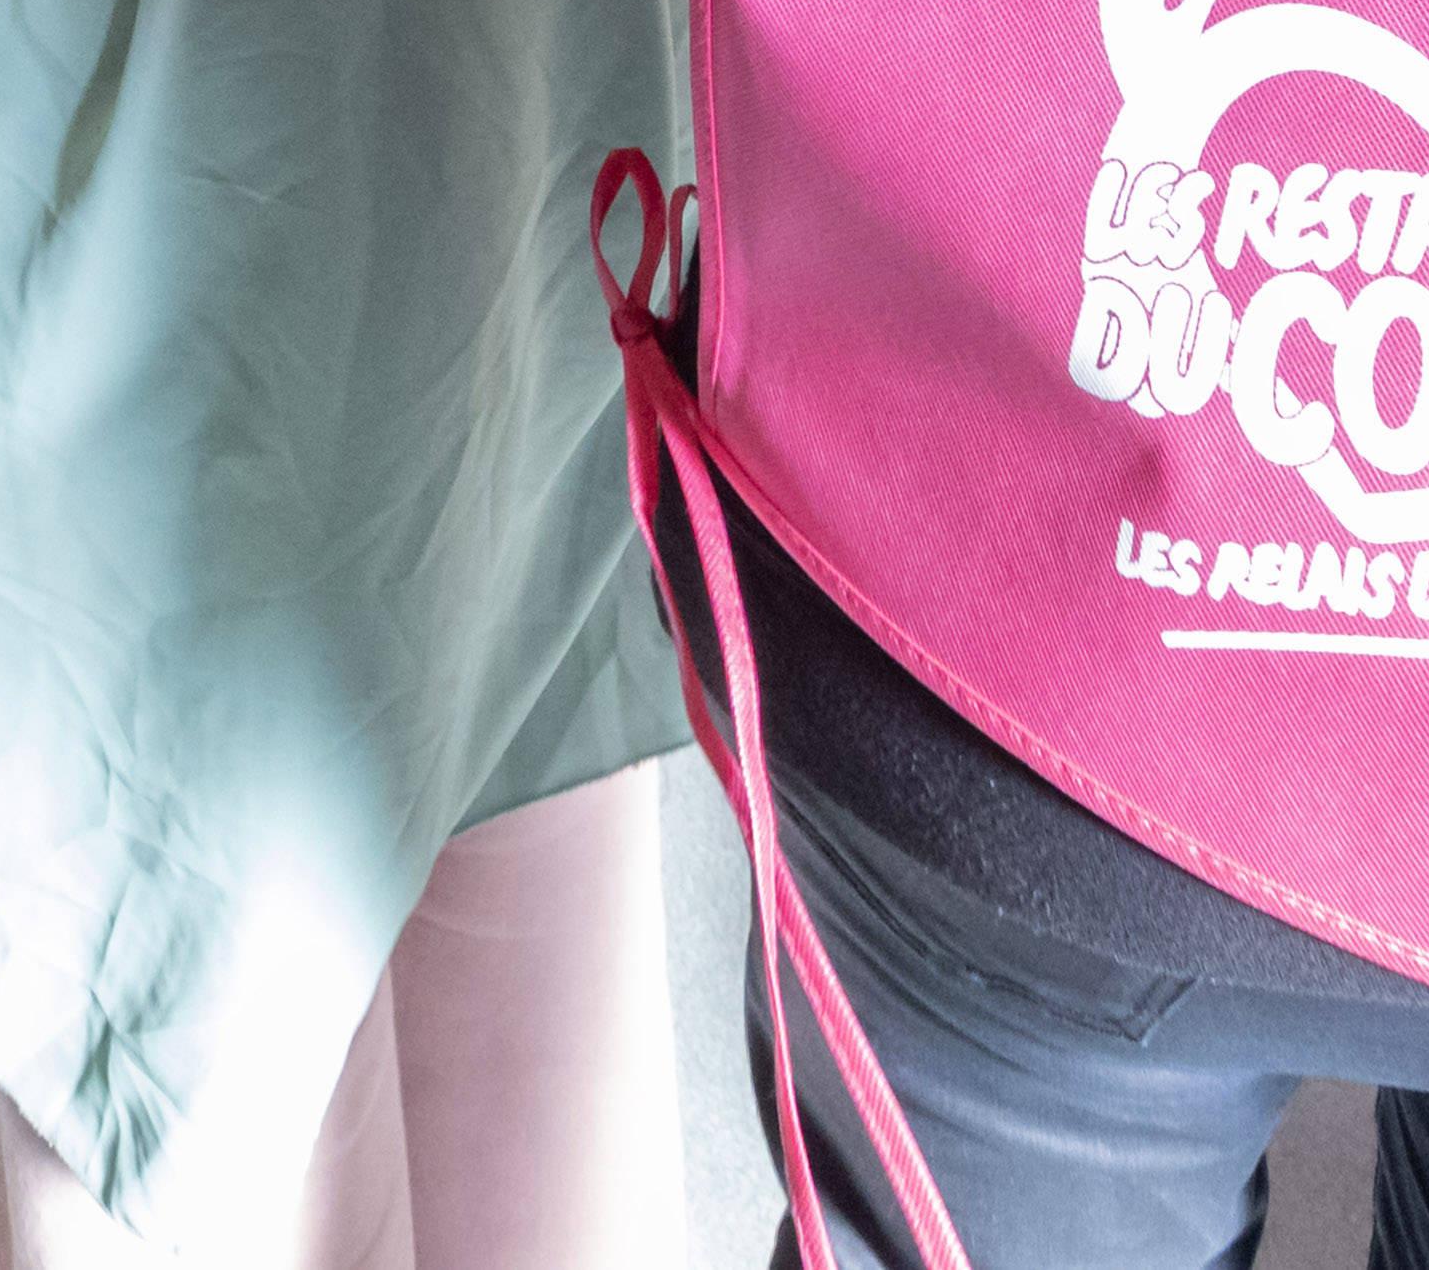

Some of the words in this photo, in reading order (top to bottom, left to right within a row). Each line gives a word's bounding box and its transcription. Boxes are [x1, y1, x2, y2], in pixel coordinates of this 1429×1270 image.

[1083, 158, 1215, 271] LES
[1068, 275, 1233, 417] DU
[1115, 517, 1203, 597] LES
[1207, 541, 1401, 620] RELAIS
